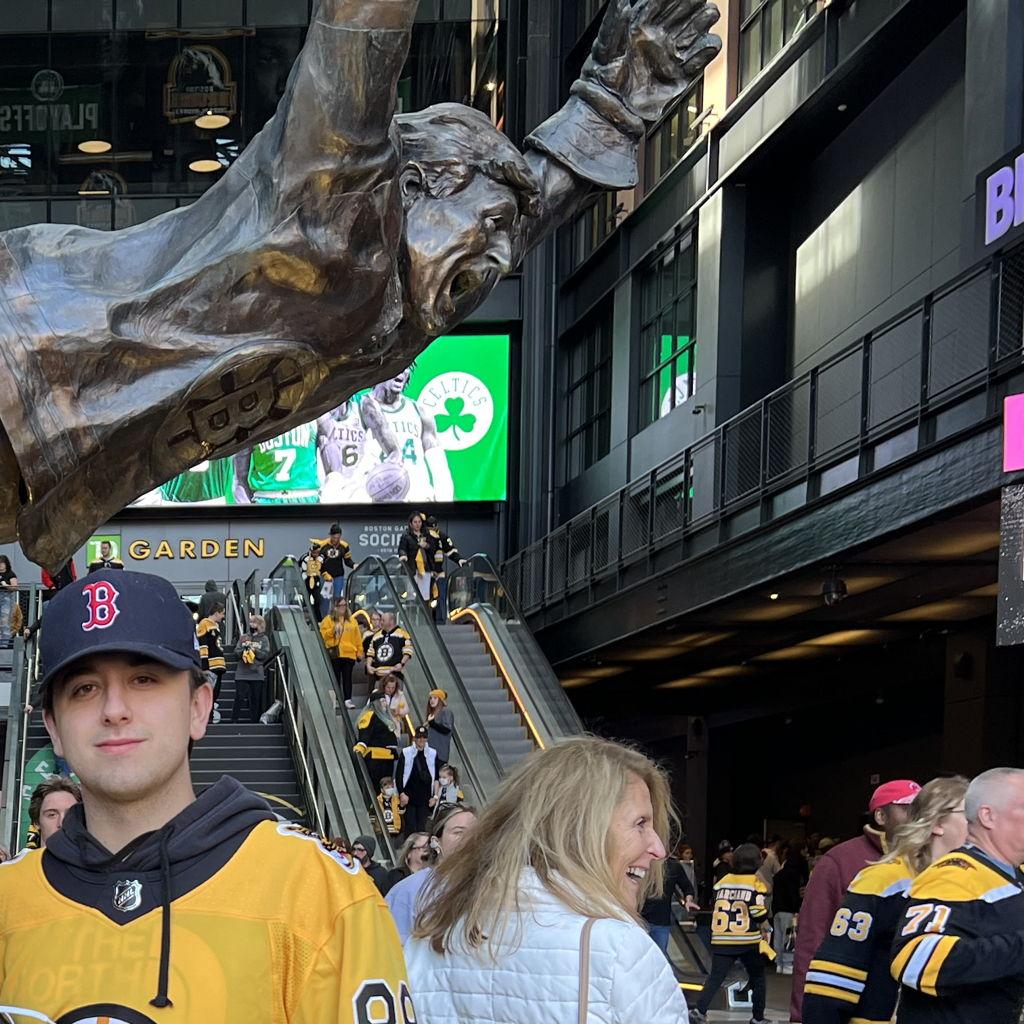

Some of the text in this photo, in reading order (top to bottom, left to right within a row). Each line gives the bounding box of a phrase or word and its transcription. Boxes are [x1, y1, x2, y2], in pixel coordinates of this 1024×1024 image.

[422, 377, 488, 407] CELTICS
[392, 420, 419, 438] TICS
[274, 448, 297, 482] 7
[341, 444, 359, 468] 6
[128, 537, 266, 560] GARDEN
[81, 579, 120, 632] B
[711, 899, 751, 934] 63
[829, 907, 874, 942] 63
[901, 903, 952, 937] 71
